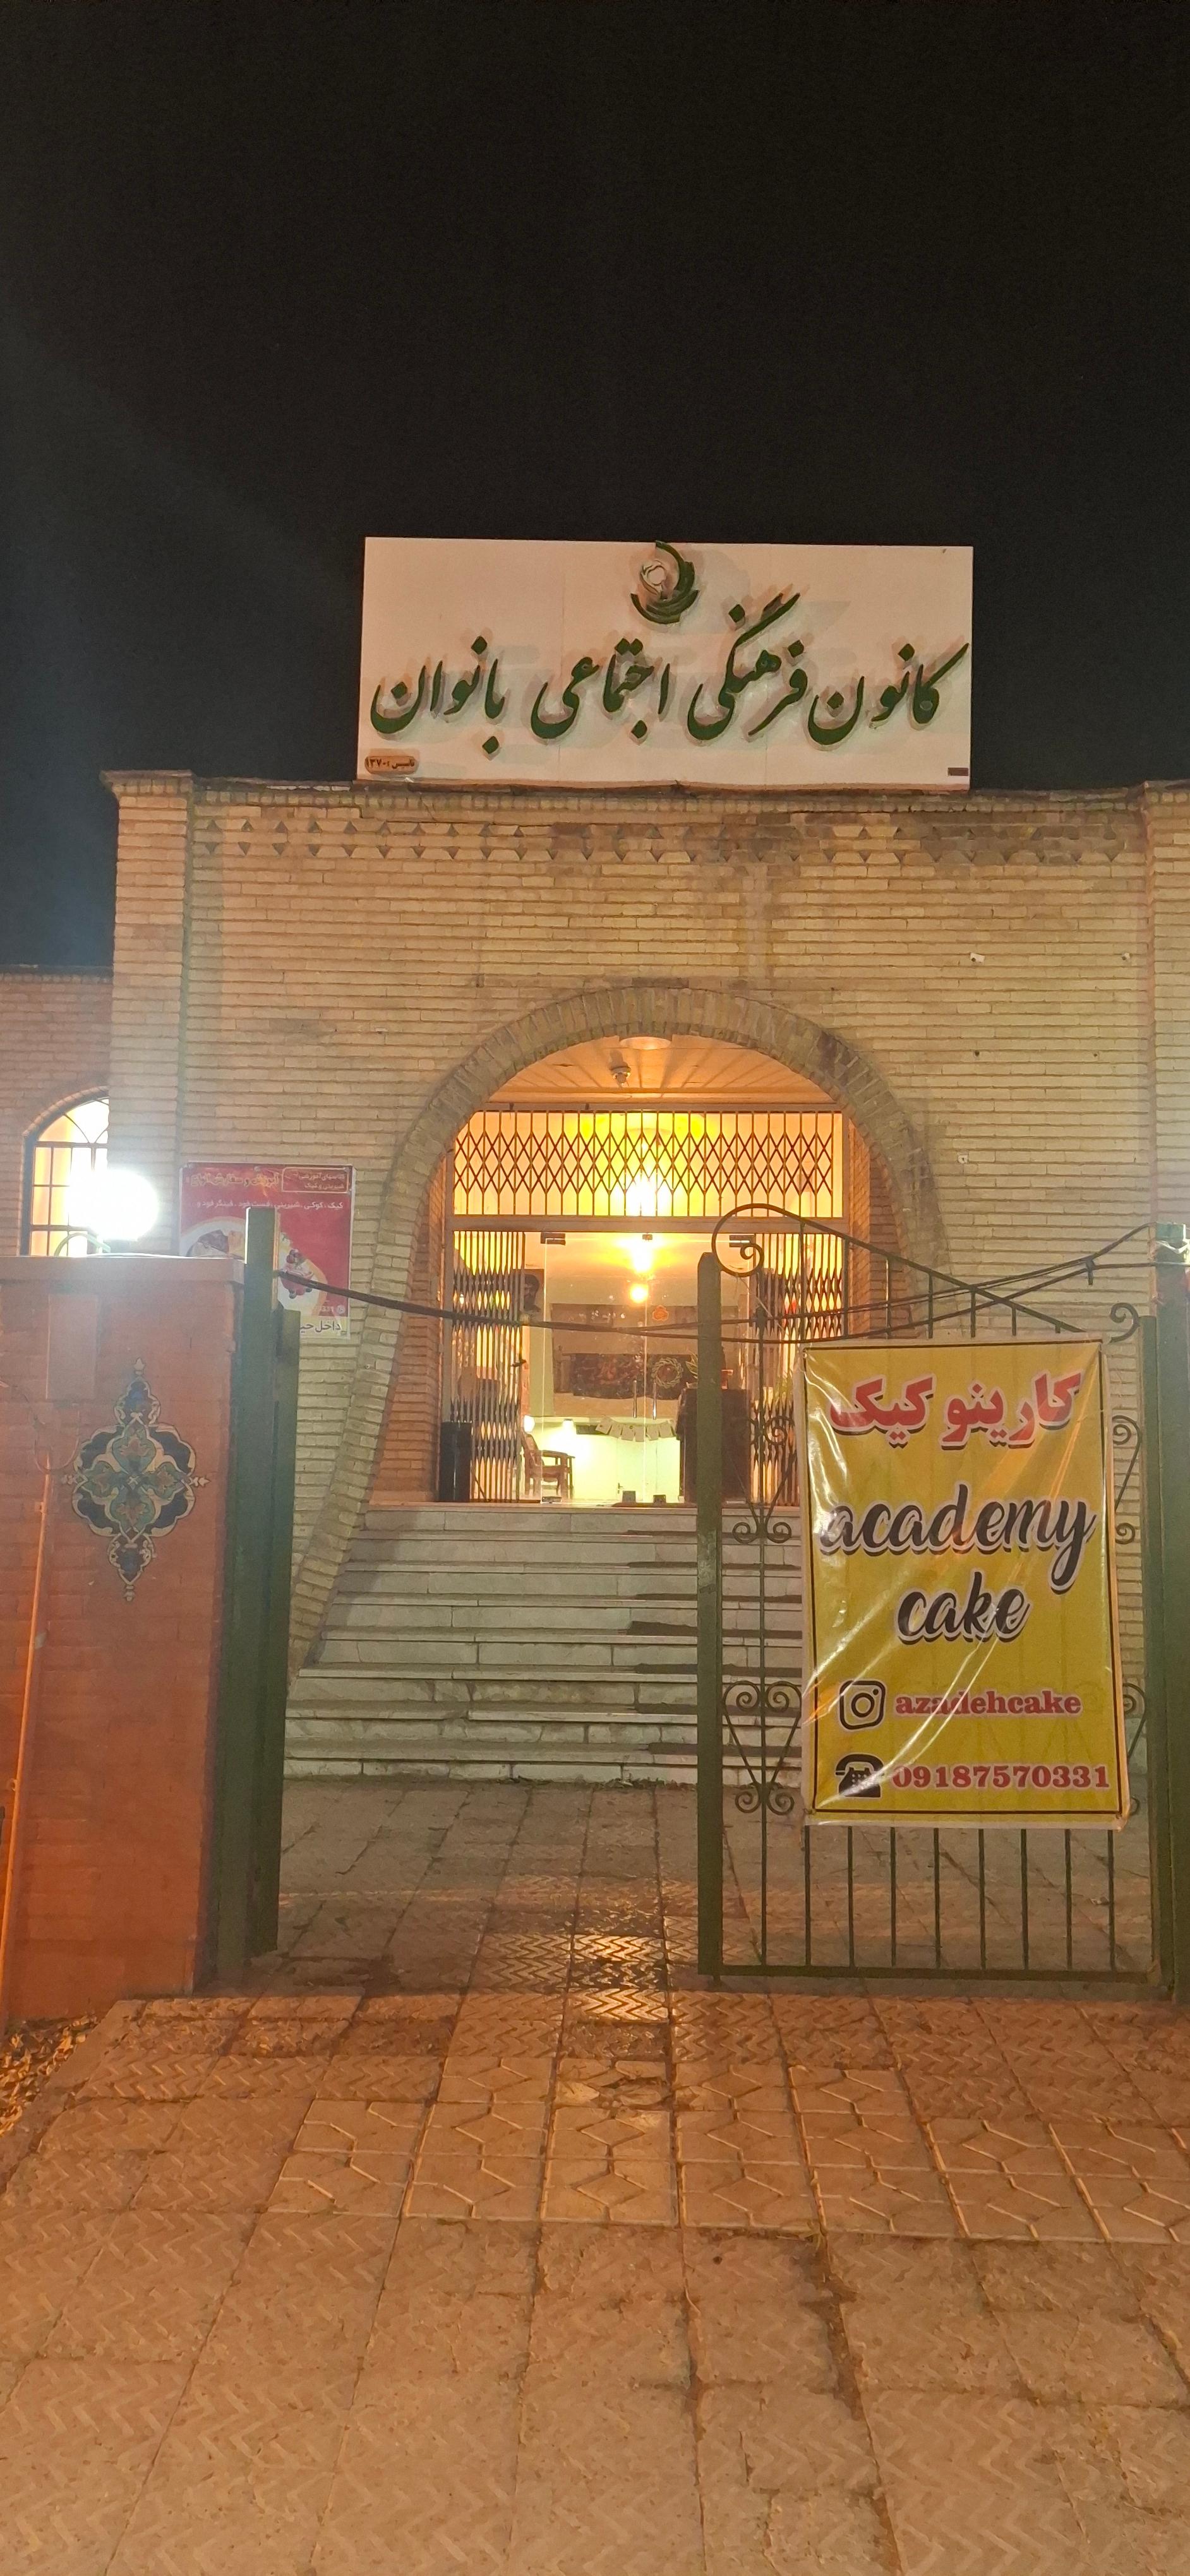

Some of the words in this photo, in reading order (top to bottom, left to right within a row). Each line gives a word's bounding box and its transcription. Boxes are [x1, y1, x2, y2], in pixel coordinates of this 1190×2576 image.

[370, 635, 506, 755] بانوان
[530, 637, 671, 740] اجتماعی
[687, 592, 808, 741] فرهنگی
[808, 642, 970, 746] کانون
[212, 1172, 243, 1187] سفارش
[243, 1178, 251, 1188] و
[315, 1320, 341, 1333] داخل
[829, 1376, 935, 1442] کیک
[941, 1372, 1083, 1445] کارینو
[819, 1482, 1097, 1588] academy
[896, 1570, 1031, 1638] cake
[894, 1690, 1083, 1715] azadehcake
[891, 1764, 1110, 1789] 09187570331
